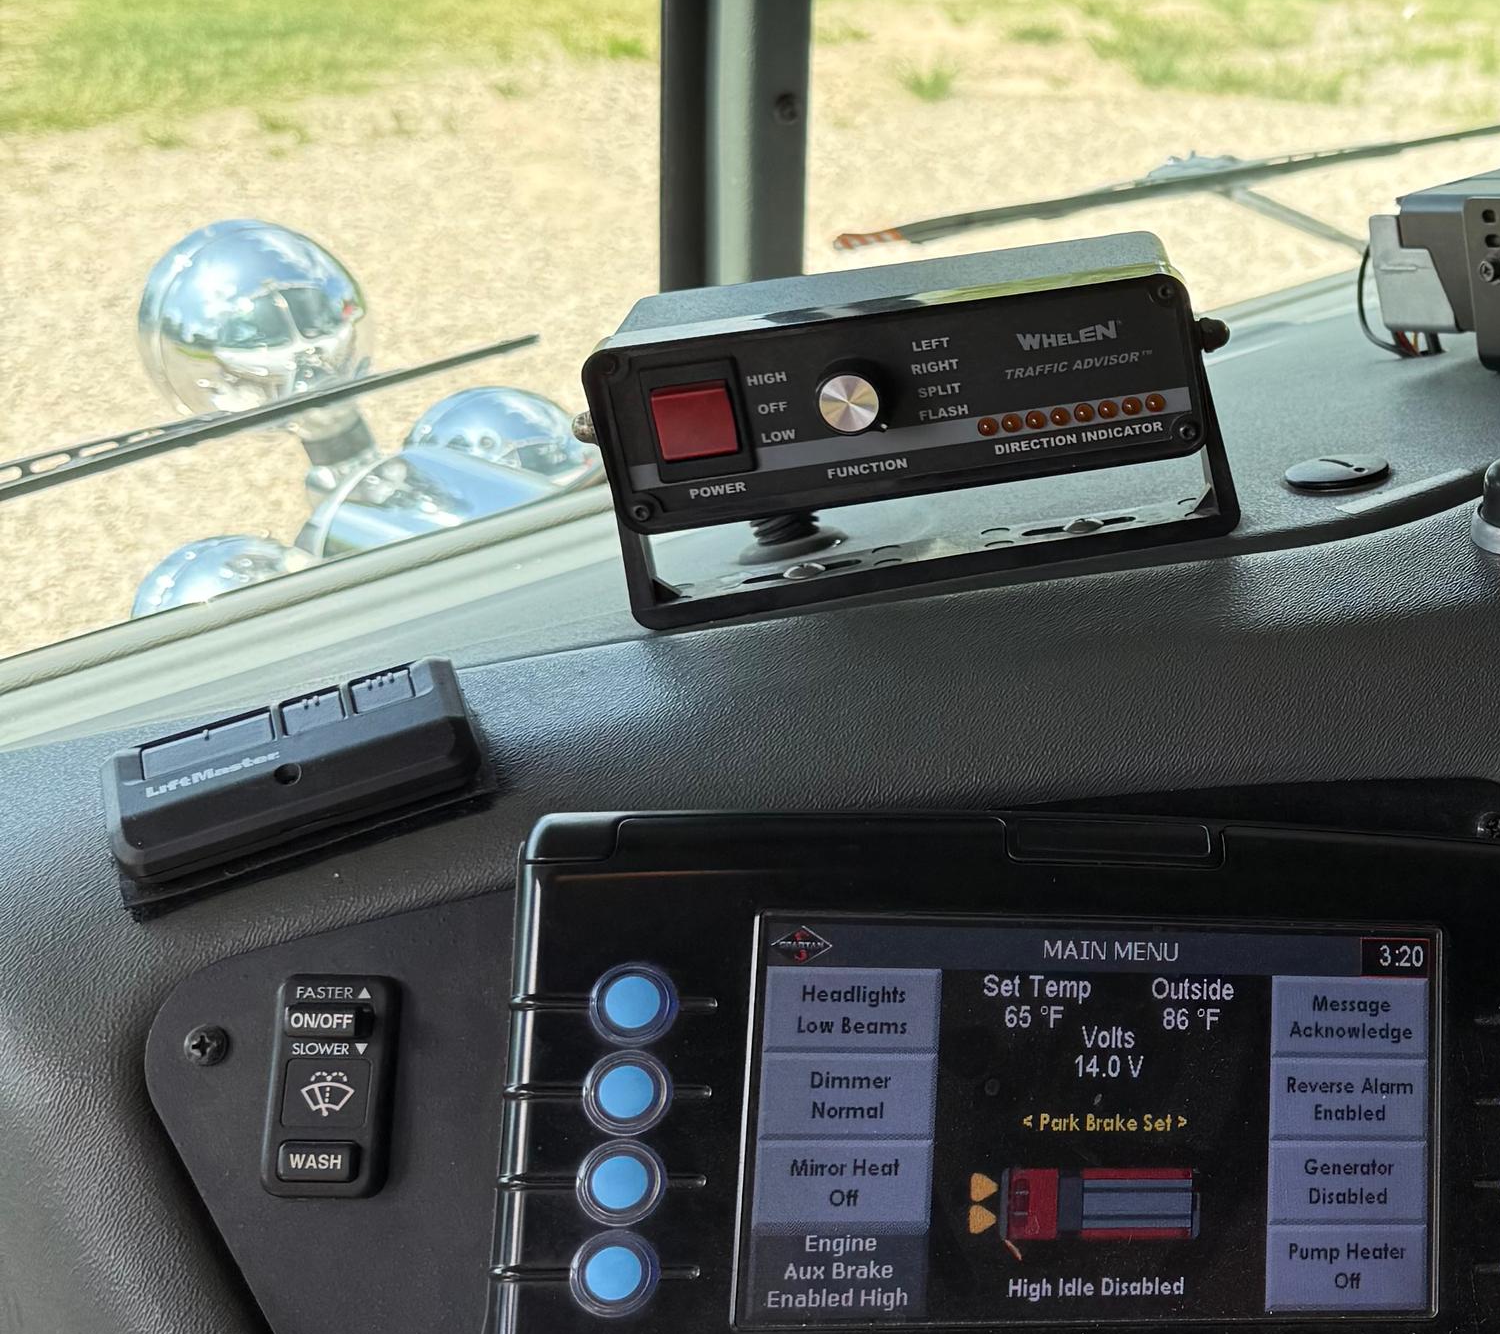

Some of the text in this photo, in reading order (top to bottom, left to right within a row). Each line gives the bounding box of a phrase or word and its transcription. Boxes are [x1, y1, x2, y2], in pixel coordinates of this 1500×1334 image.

[911, 337, 950, 352] LEFT
[1016, 320, 1118, 351] WHELEN
[911, 359, 959, 376] RIGHT
[1004, 361, 1068, 380] TRAFFIC
[746, 371, 787, 387] HIGH
[917, 383, 961, 399] SPLIT
[757, 401, 788, 415] OFF
[919, 404, 969, 421] FLASH
[761, 429, 796, 443] LOW
[994, 421, 1163, 455] DIRECTION INDICATOR
[827, 458, 908, 479] FUNCTION
[689, 482, 747, 499] POWER
[145, 751, 281, 798] LiftMaster
[1043, 940, 1179, 961] MAIN MENU
[1379, 944, 1424, 967] 3:20
[296, 986, 353, 999] FASTER
[801, 984, 906, 1008] Headlights
[983, 974, 1092, 1005] Set Temp
[1151, 977, 1235, 1001] Outside
[1312, 994, 1392, 1017] Message
[290, 1012, 353, 1029] ON/OFF
[796, 1015, 907, 1034] Low Beams
[1004, 1005, 1032, 1028] 65
[1162, 1007, 1189, 1030] 86
[1081, 1025, 1136, 1049] Volts
[1289, 1021, 1413, 1044] Acknowledge
[292, 1042, 350, 1056] SLOWER
[1074, 1054, 1145, 1078] 14.0 V
[810, 1071, 892, 1089] Dimmer
[1286, 1076, 1414, 1095] Reverse Alarm
[811, 1101, 885, 1120] Normal
[1314, 1104, 1387, 1122] Enabled
[1039, 1113, 1080, 1132] Park
[1086, 1113, 1138, 1132] Brake
[1143, 1113, 1172, 1132] Set
[289, 1153, 342, 1170] WASH
[789, 1158, 900, 1177] Mirror Heat
[1304, 1158, 1395, 1176] Generator
[829, 1189, 859, 1207] Off
[1308, 1187, 1388, 1205] Disabled
[805, 1234, 877, 1257] Engine
[1288, 1242, 1407, 1264] Pump Heater
[784, 1259, 894, 1280] Aux Brake
[1008, 1276, 1185, 1302] High Idle Disabled
[1334, 1272, 1361, 1289] Off
[767, 1287, 908, 1311] Enabled High
